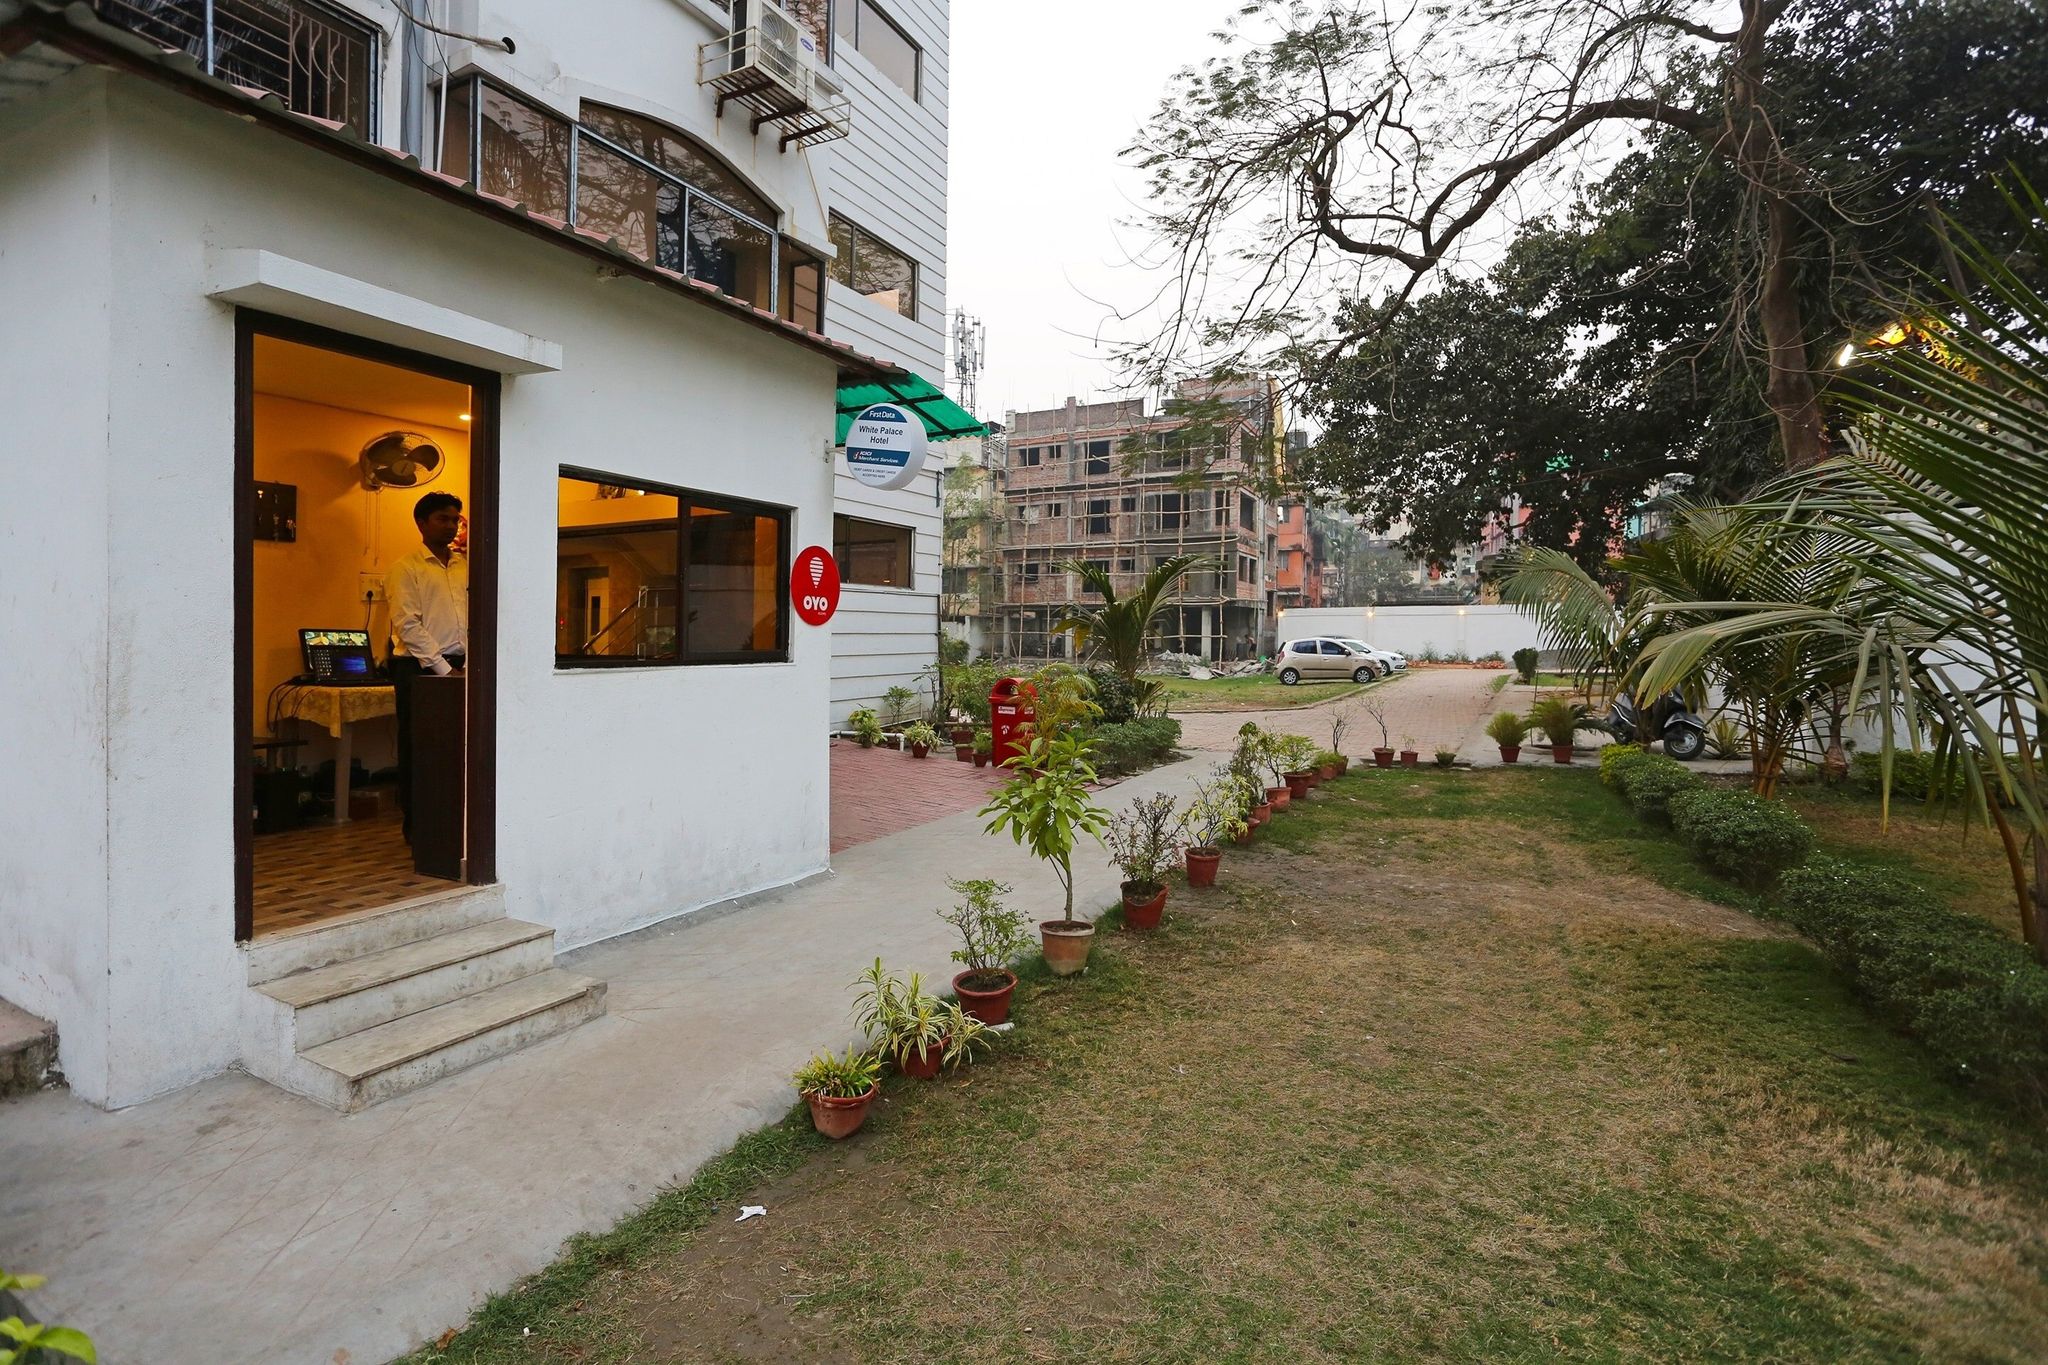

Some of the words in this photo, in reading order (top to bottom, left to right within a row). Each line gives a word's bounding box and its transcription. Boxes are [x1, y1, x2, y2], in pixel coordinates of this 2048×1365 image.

[881, 411, 896, 419] Data
[859, 425, 879, 434] White
[880, 426, 904, 436] Palace
[870, 436, 889, 444] Hotel
[803, 595, 828, 611] OYO
